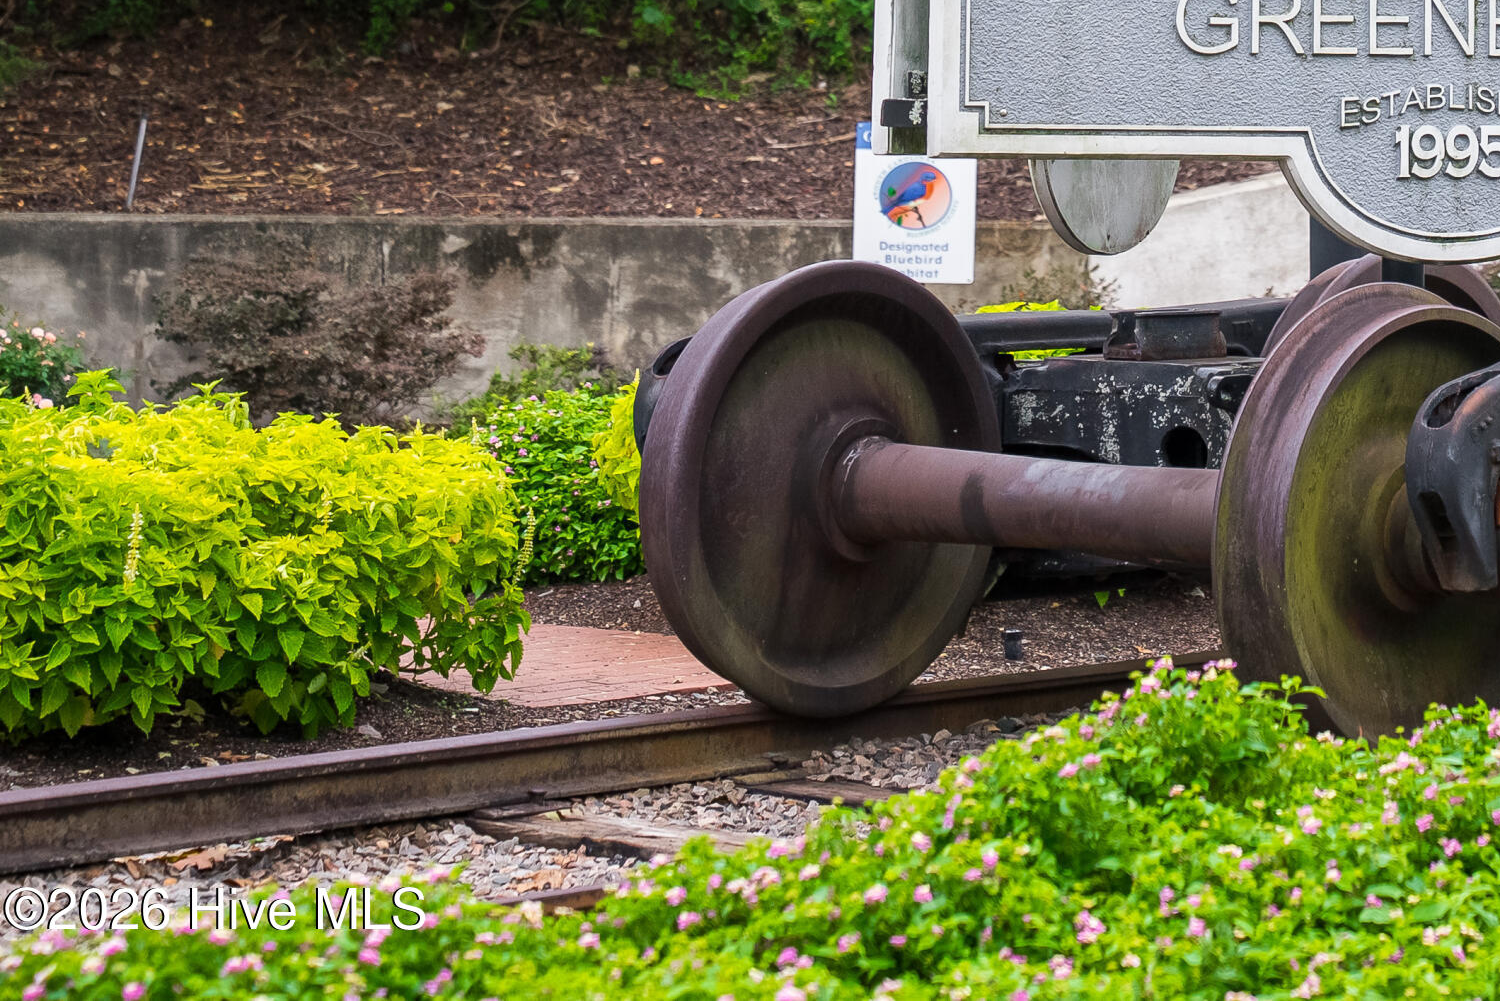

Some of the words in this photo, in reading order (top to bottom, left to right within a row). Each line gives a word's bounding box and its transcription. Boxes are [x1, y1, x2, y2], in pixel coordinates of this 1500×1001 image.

[879, 241, 949, 254] Designated
[885, 254, 942, 265] Bluebird
[900, 267, 939, 279] bitat
